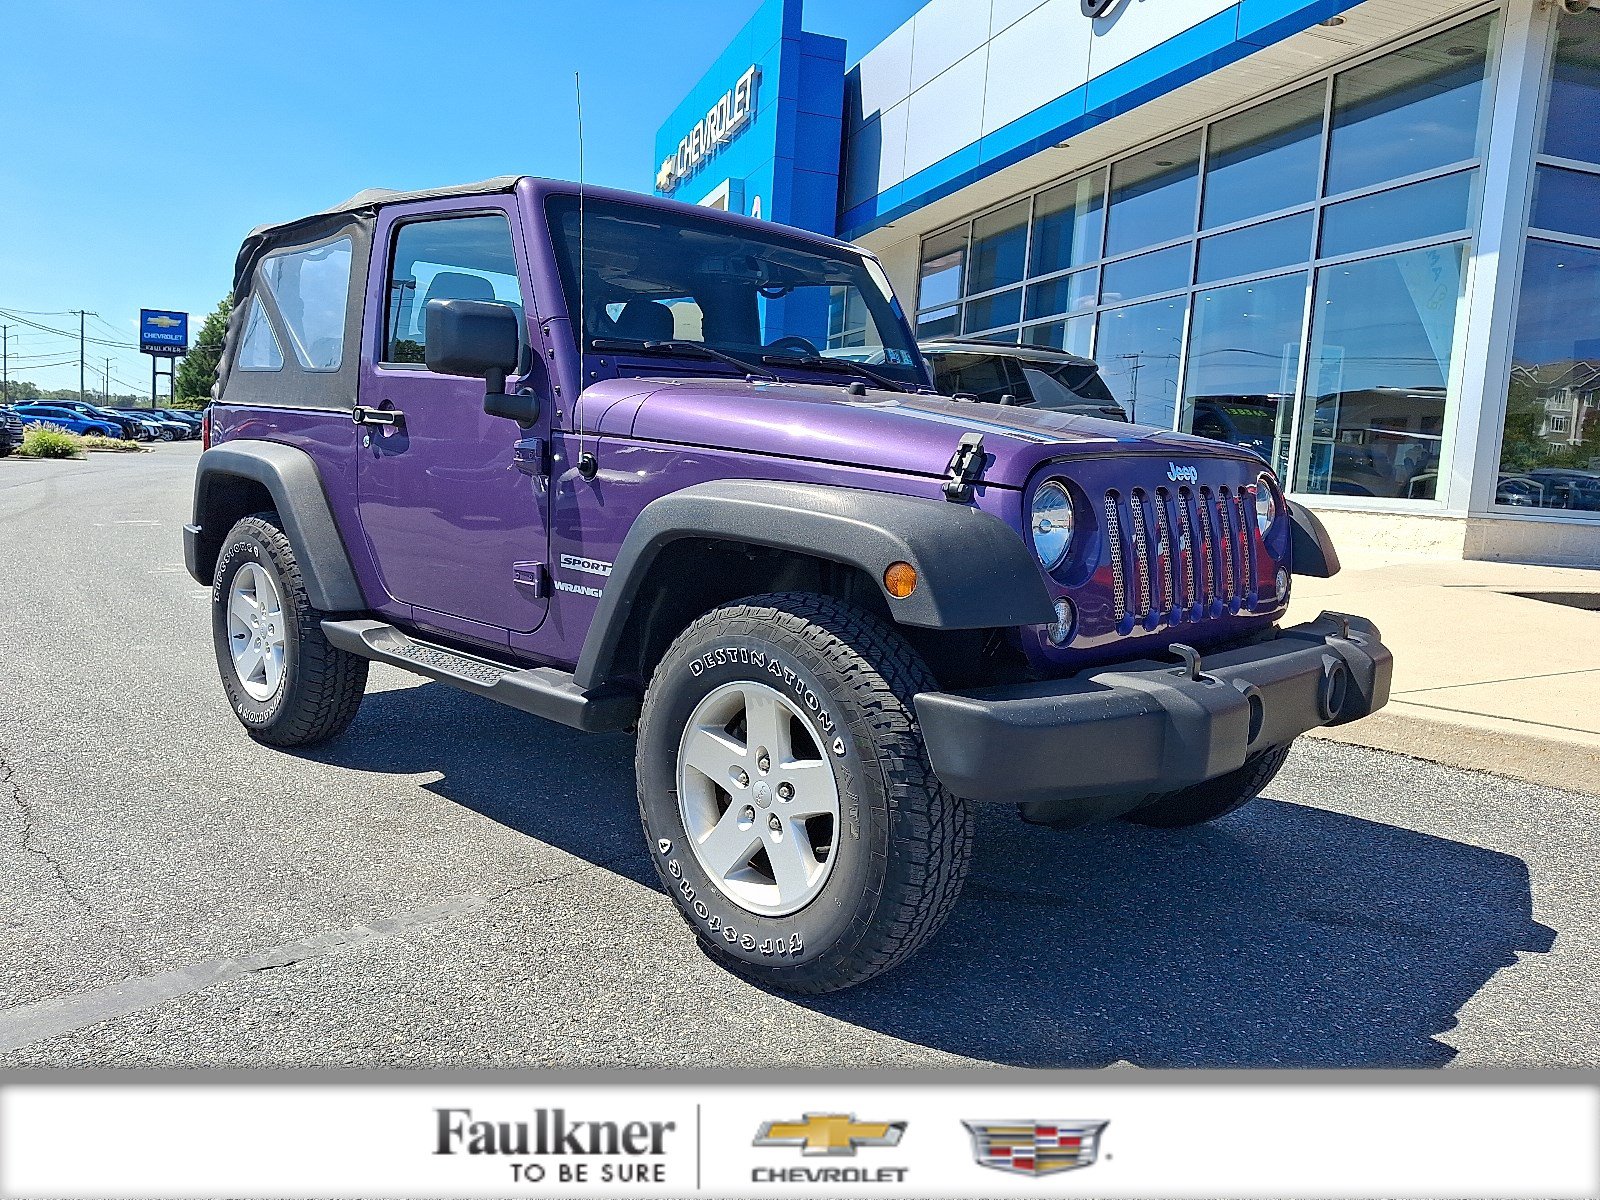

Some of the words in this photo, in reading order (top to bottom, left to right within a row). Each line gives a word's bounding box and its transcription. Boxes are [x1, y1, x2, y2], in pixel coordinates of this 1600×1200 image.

[676, 63, 756, 178] CHEVROLET
[143, 332, 183, 341] CHEVROLET
[145, 345, 181, 353] FAULKNER
[1166, 461, 1198, 485] Jeep
[561, 556, 613, 572] SPORT
[689, 648, 835, 734] DESTINATION
